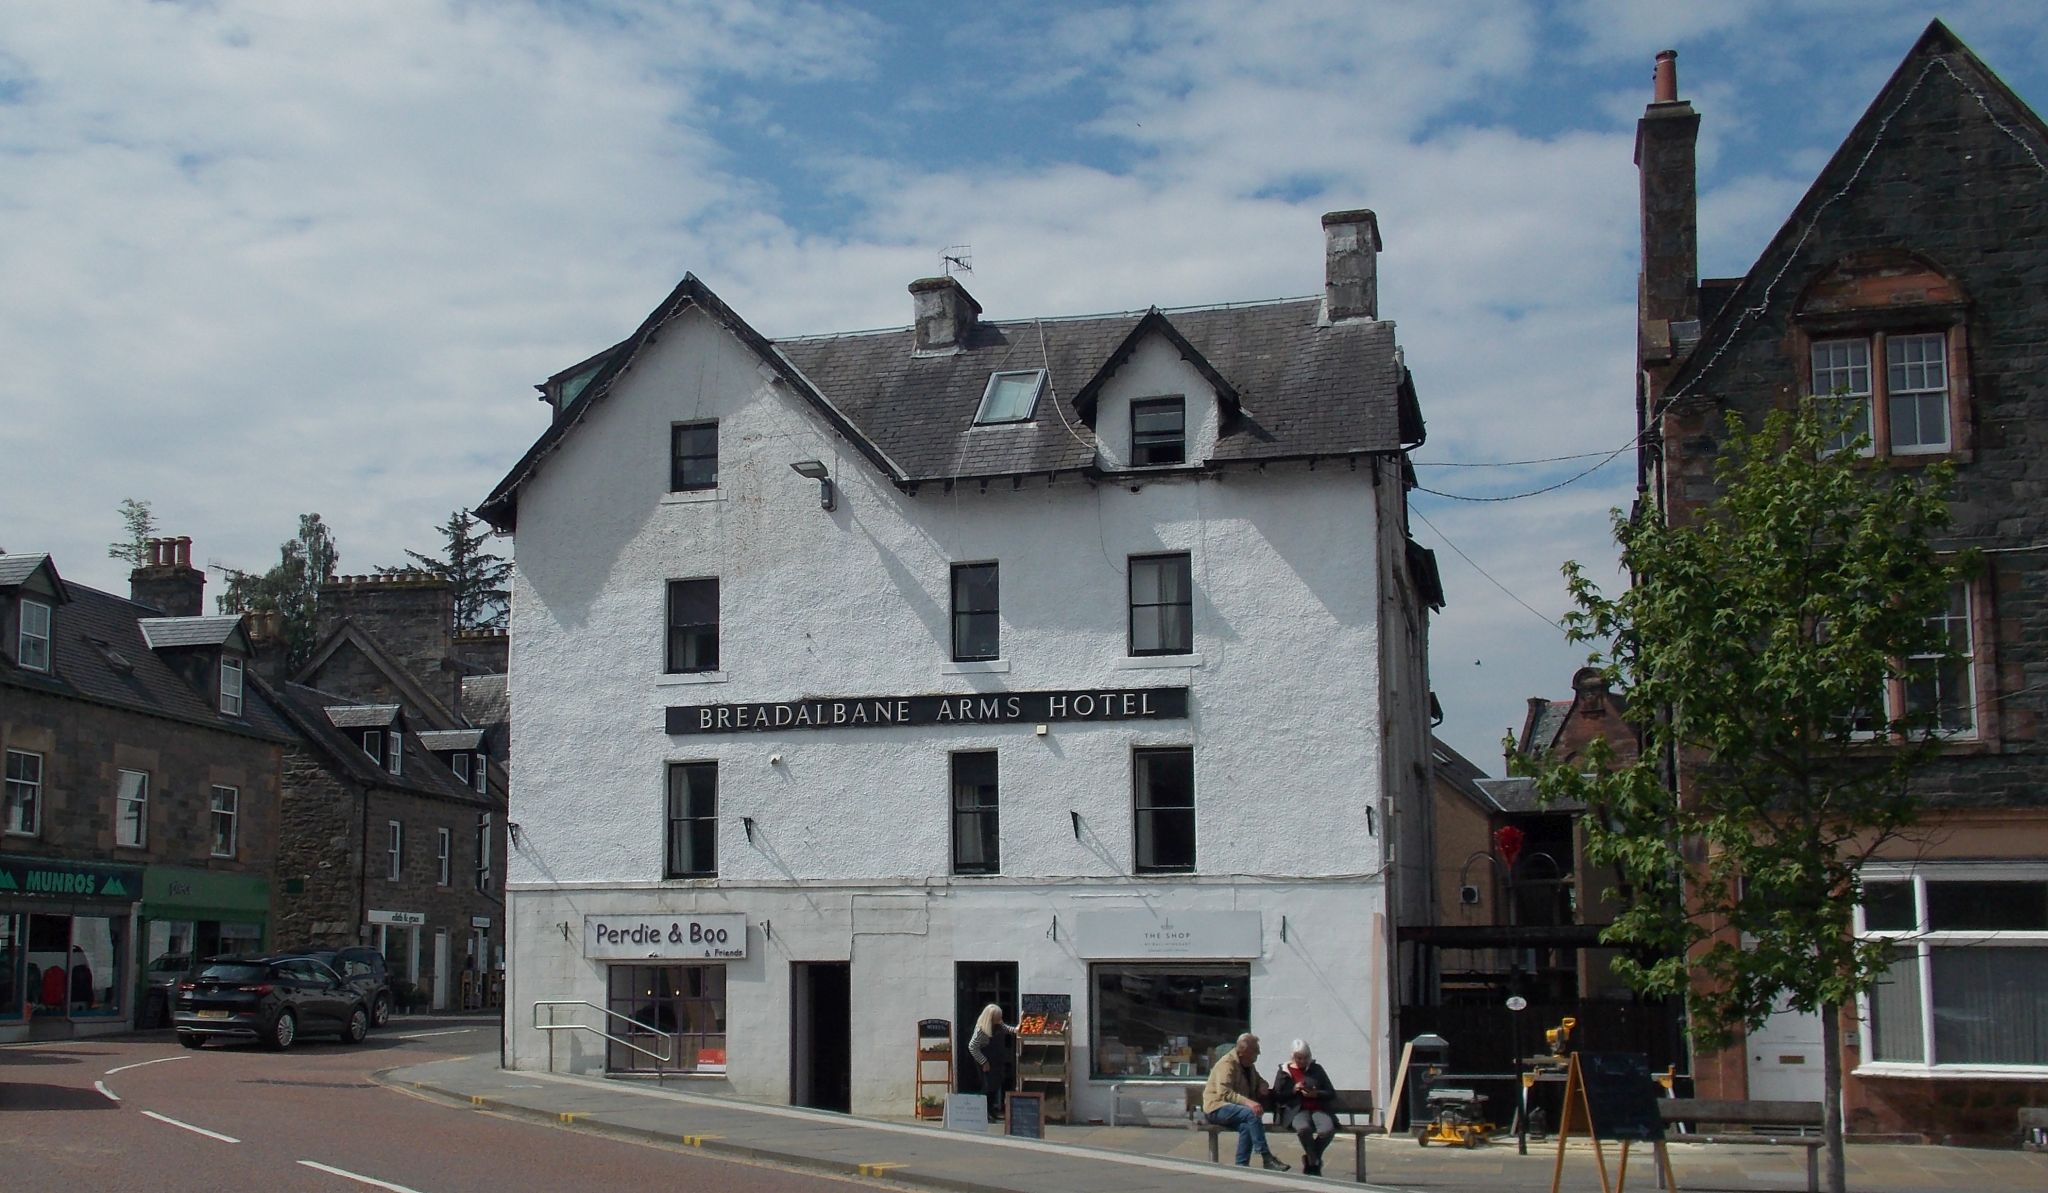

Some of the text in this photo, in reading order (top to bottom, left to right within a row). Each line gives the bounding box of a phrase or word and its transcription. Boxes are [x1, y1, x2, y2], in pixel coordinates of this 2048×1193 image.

[699, 693, 1156, 729] BREADALBANE ARMS HOTEL
[26, 871, 95, 894] MUNROS
[596, 923, 728, 944] Perdie & Boo
[715, 949, 743, 957] Friends
